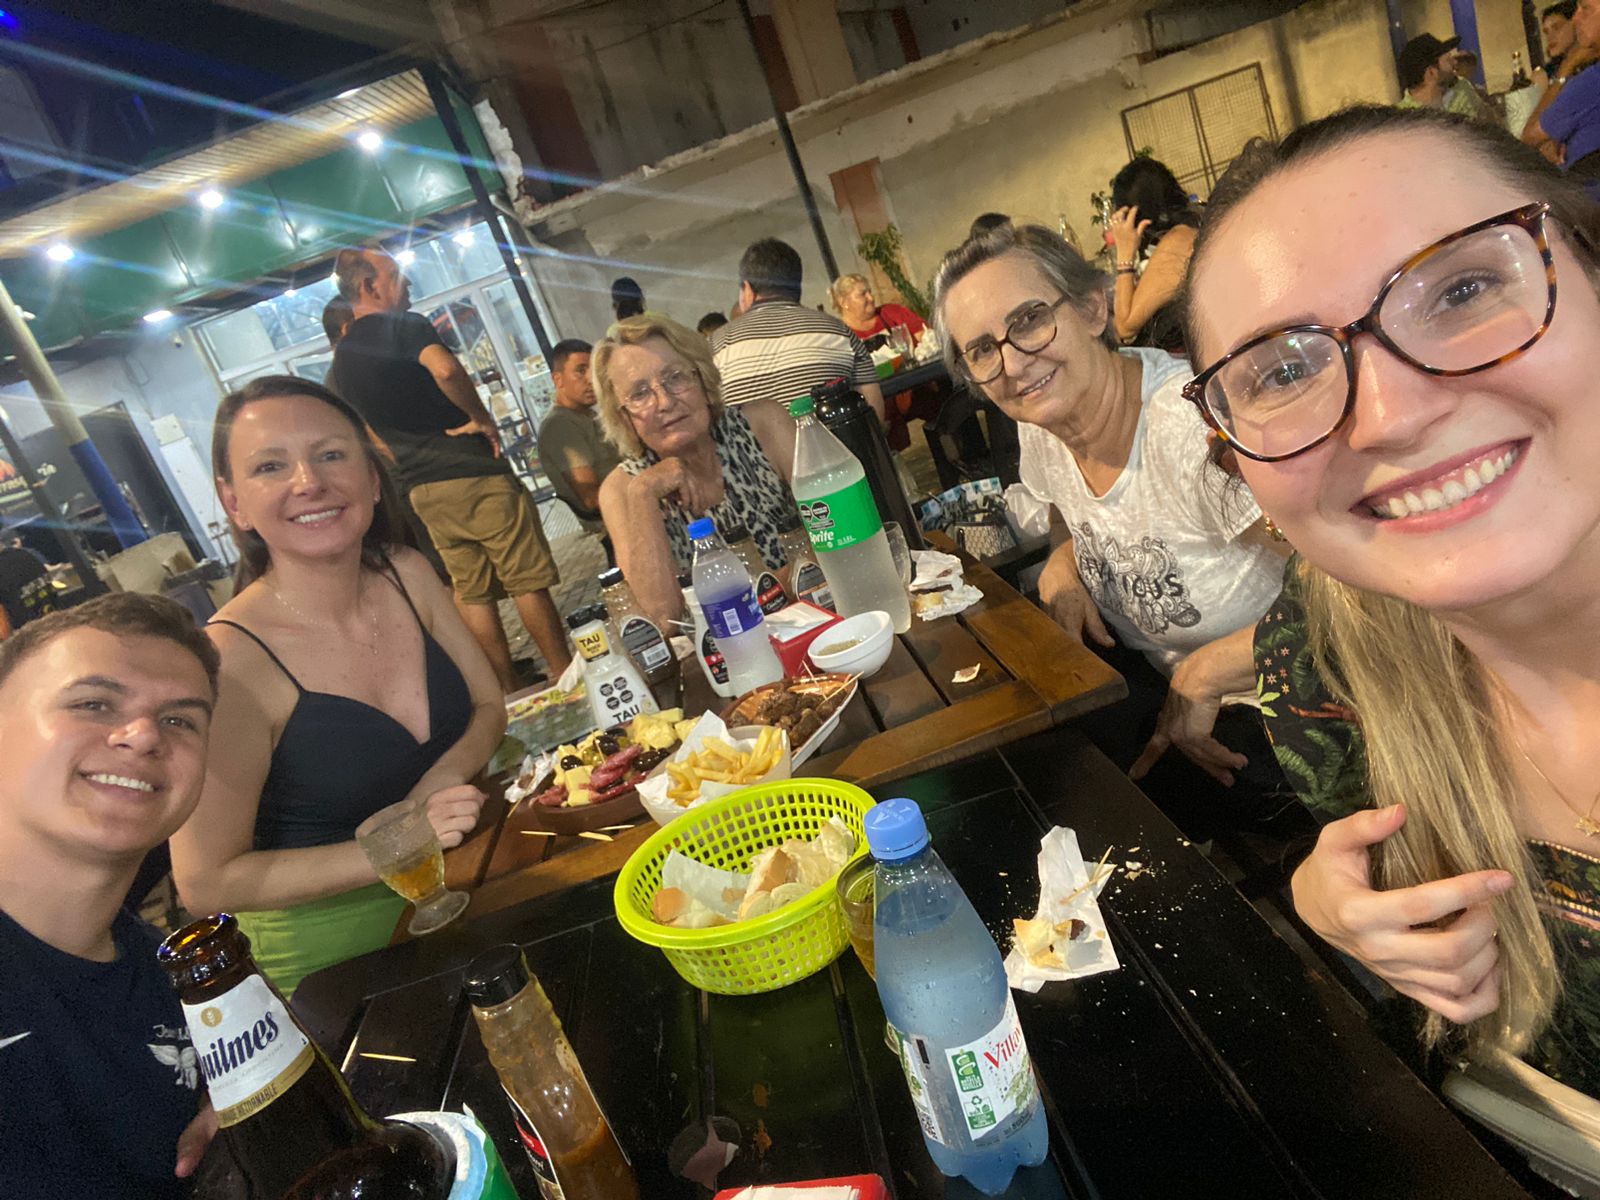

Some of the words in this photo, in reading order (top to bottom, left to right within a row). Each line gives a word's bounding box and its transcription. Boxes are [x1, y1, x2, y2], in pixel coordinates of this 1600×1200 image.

[579, 632, 601, 648] TAU
[612, 704, 640, 724] TAU
[201, 1010, 279, 1086] uilmes
